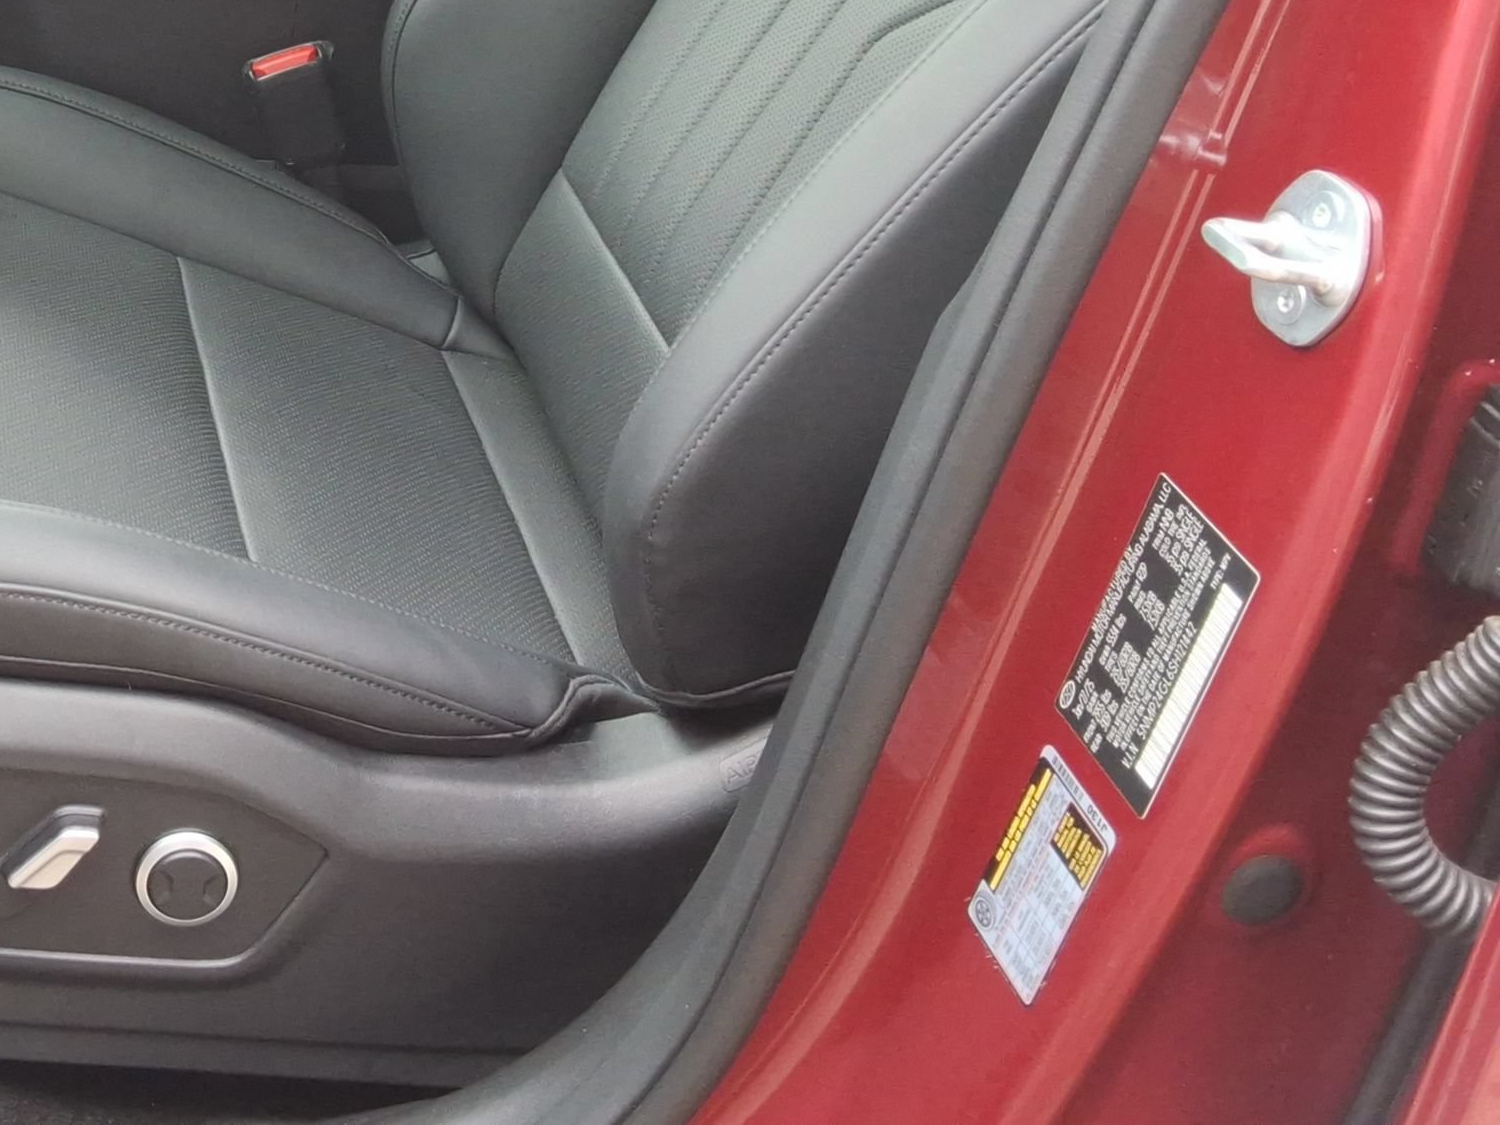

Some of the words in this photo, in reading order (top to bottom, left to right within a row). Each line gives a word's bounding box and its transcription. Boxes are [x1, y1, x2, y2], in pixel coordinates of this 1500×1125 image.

[1175, 507, 1195, 543] SINGLE
[1182, 517, 1203, 552] SINGLE
[1075, 644, 1096, 683] HYUNDAI
[1092, 611, 1110, 647] MOTOR
[1105, 543, 1143, 616] MANUFACTURING
[1158, 482, 1171, 503] LLC
[1091, 560, 1127, 632] MANUFACTURED
